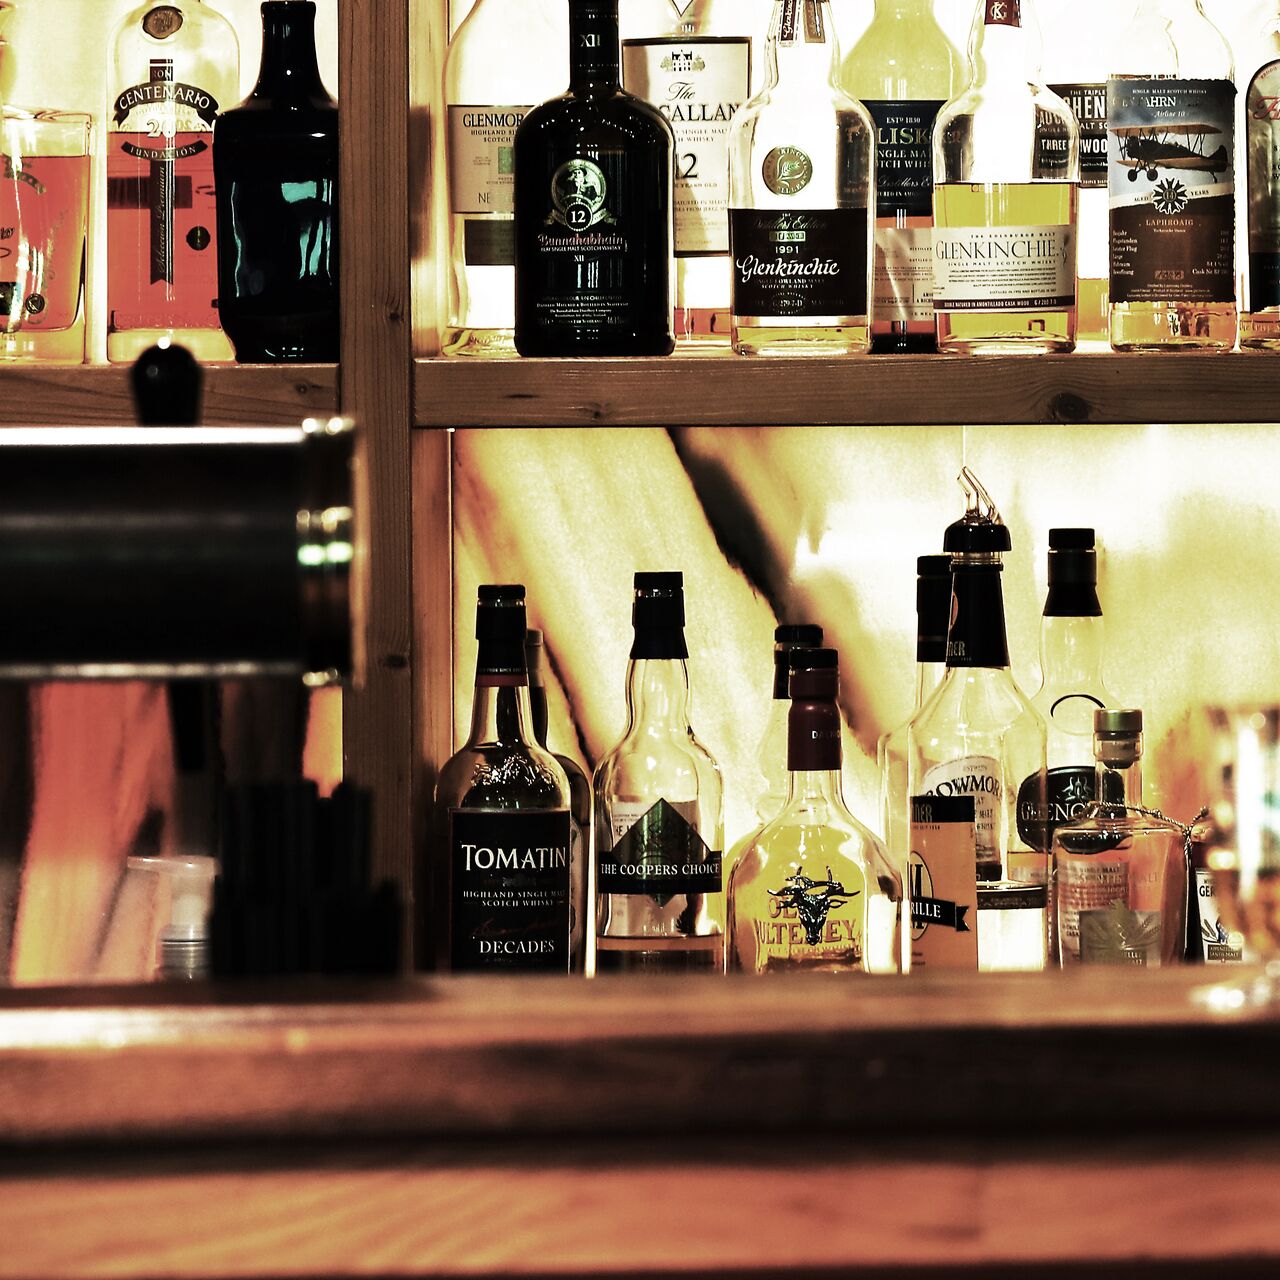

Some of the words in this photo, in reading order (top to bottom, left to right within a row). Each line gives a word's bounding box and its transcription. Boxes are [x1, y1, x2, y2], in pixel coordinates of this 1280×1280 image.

[119, 86, 210, 111] CENTENARIO
[669, 82, 695, 100] The
[570, 211, 586, 223] 12
[775, 246, 799, 254] 1991
[736, 255, 840, 282] Glenkinchie
[462, 844, 565, 871] TOMATIN
[601, 864, 617, 875] THE
[620, 864, 677, 875] COOPERS
[682, 863, 718, 874] CHOICE
[480, 940, 554, 954] DECADES
